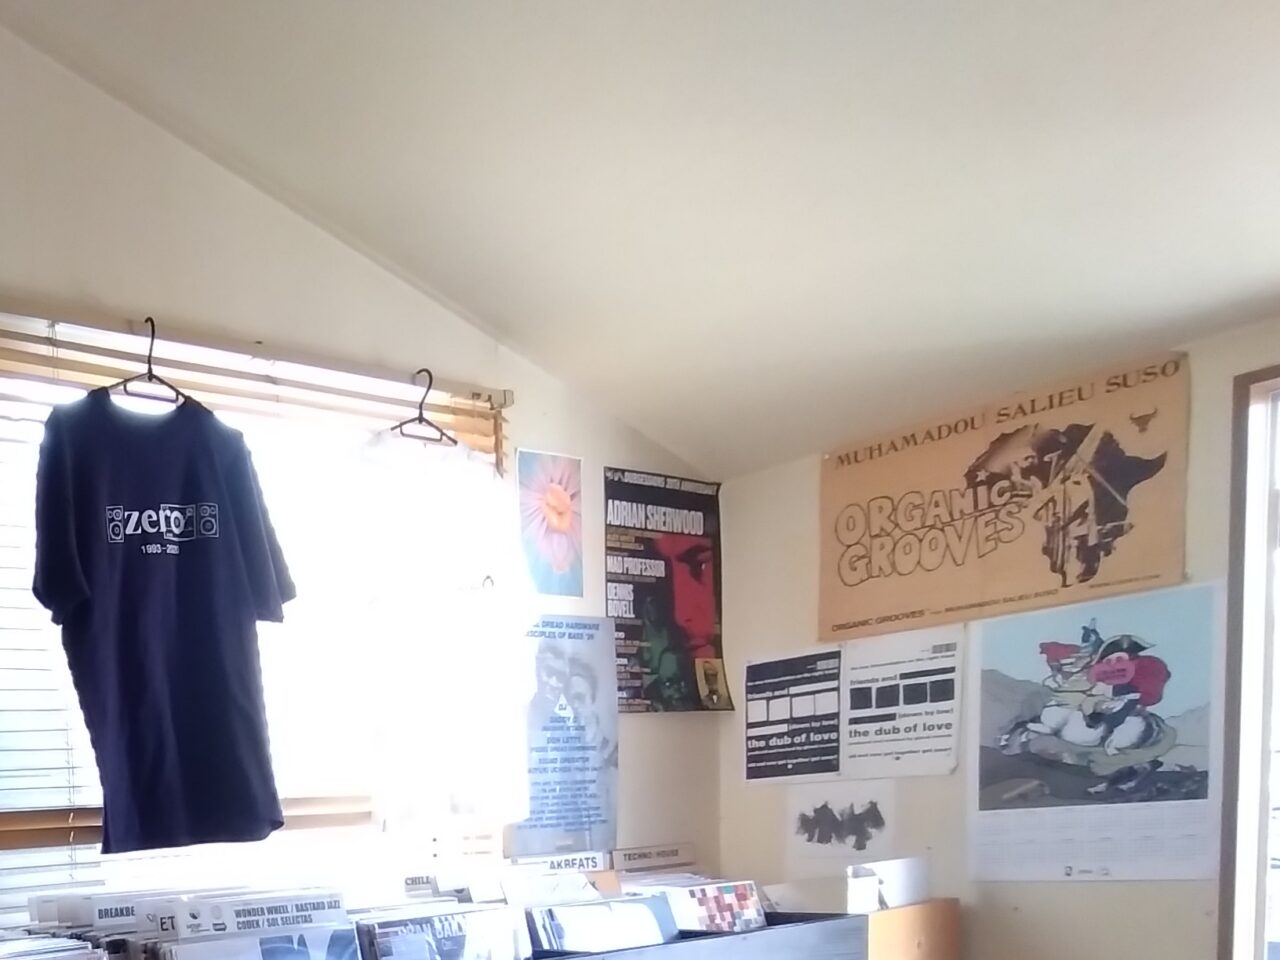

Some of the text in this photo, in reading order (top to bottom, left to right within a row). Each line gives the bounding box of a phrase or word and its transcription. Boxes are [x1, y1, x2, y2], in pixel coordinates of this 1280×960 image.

[835, 358, 1181, 470] MUHAMADOU SALIEU SUSO
[124, 509, 185, 535] zero
[606, 499, 704, 536] ADRIAN SHERWOOD
[834, 478, 1013, 547] ORGANIC
[837, 502, 1025, 588] GROOVES
[623, 557, 665, 578] PROFESSOR
[607, 600, 636, 619] BOVELL
[747, 739, 766, 749] the
[768, 735, 792, 747] dub
[793, 732, 807, 744] of
[809, 732, 838, 742] love
[849, 729, 870, 739] the
[874, 725, 900, 737] dub
[903, 723, 918, 734] of
[923, 721, 953, 733] love
[234, 907, 266, 919] WONDER
[266, 904, 290, 916] WHEEL
[295, 901, 326, 914] BASTARD
[280, 913, 313, 926] SELECTAS
